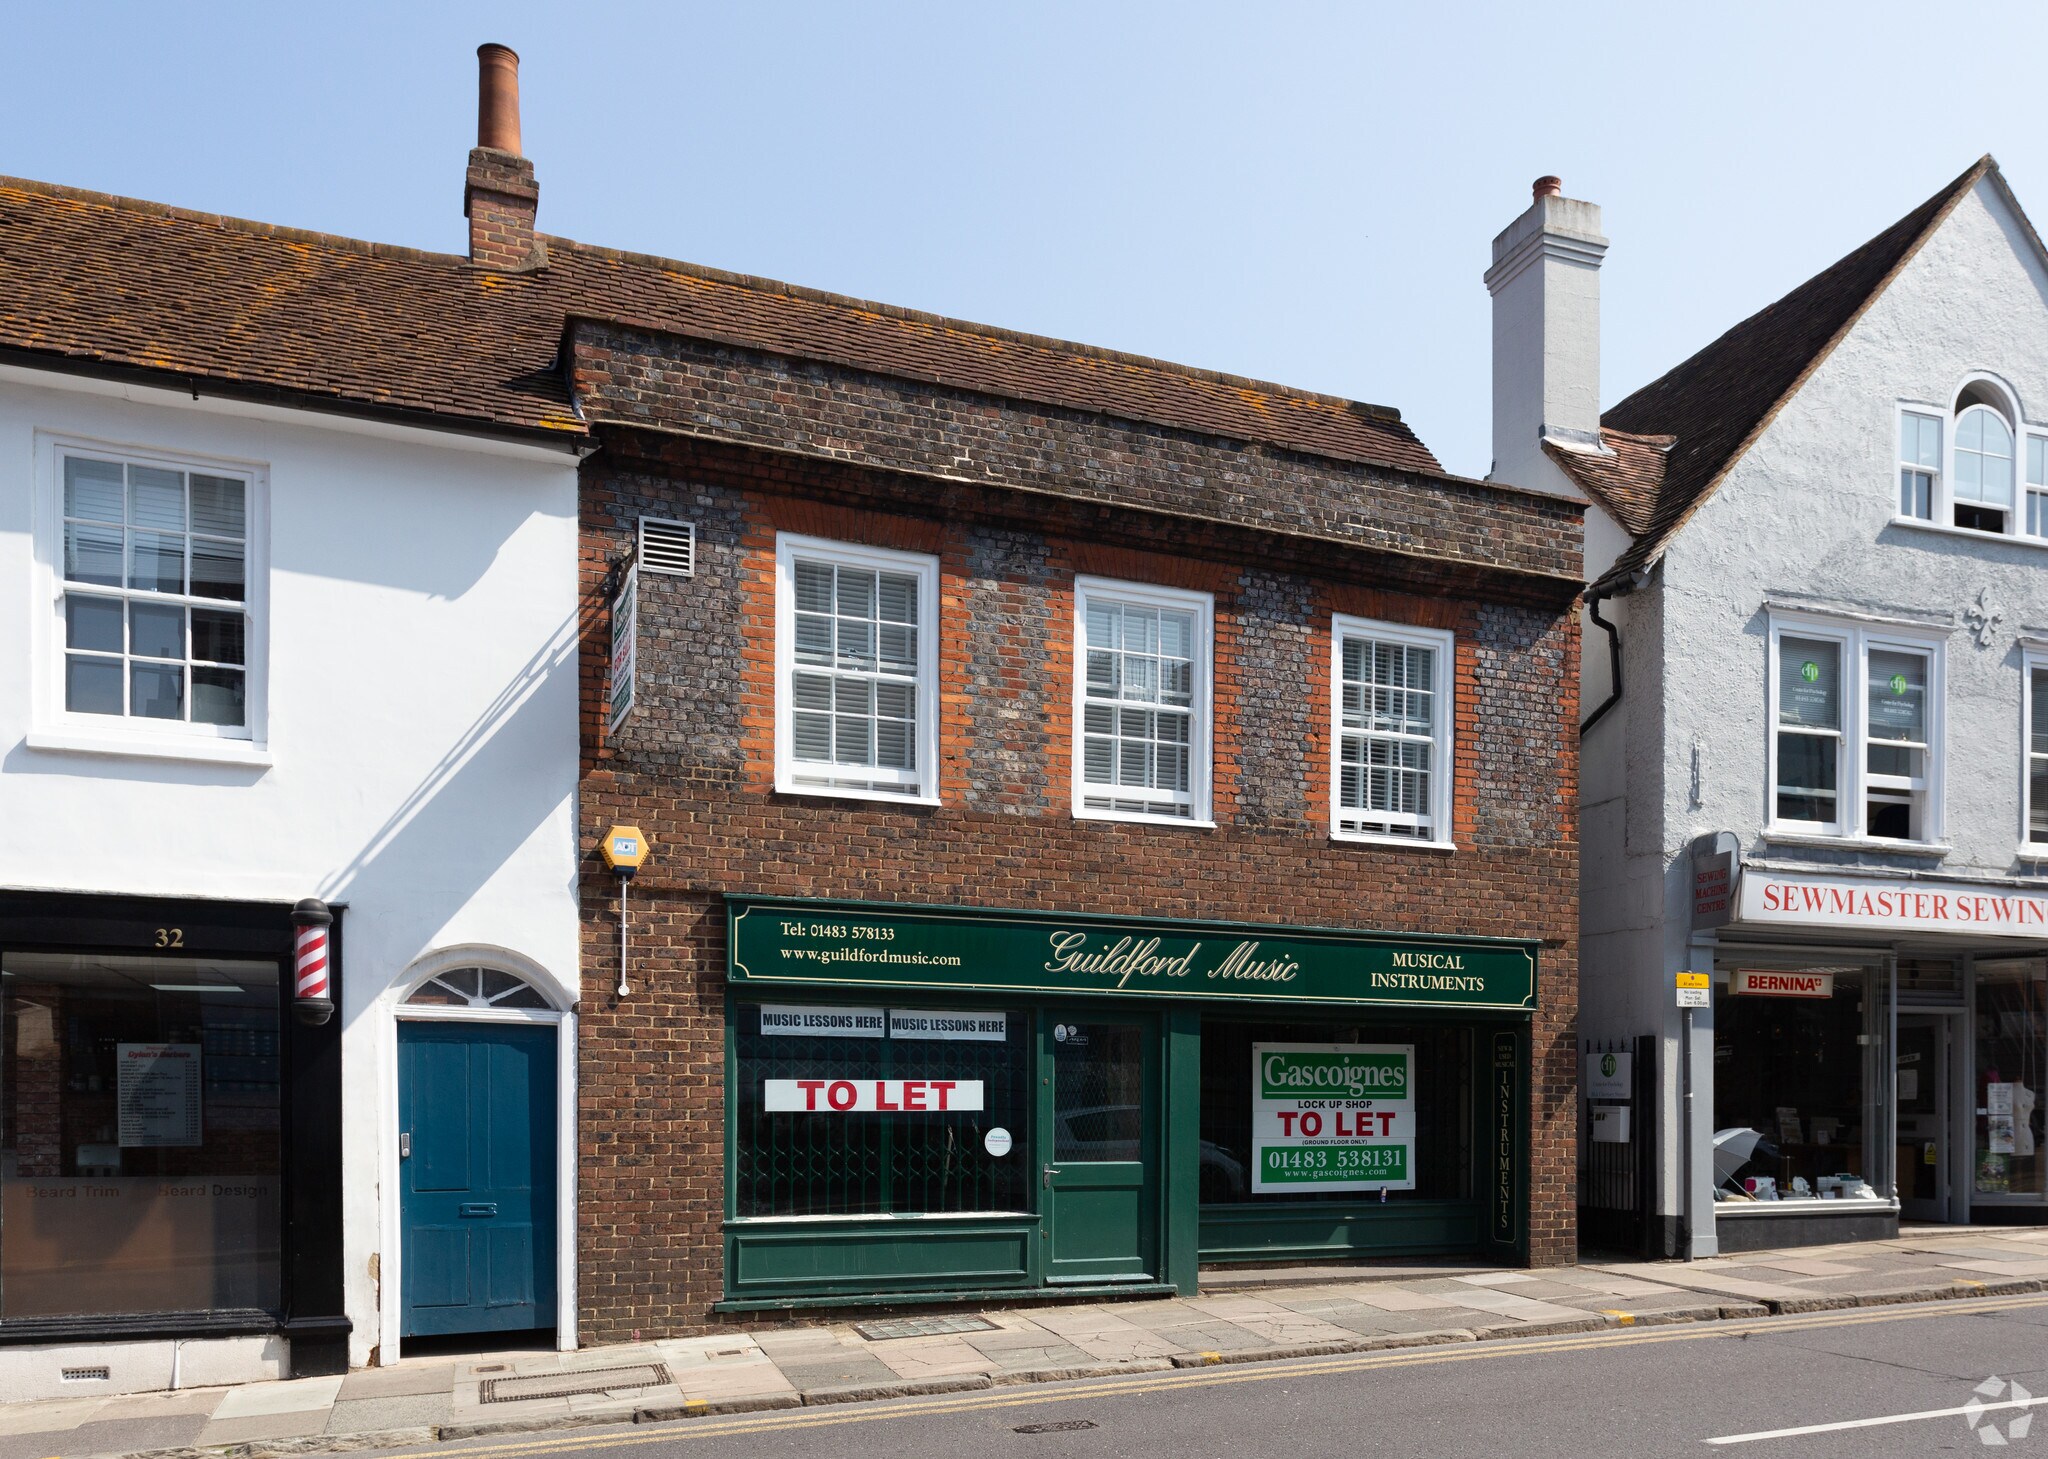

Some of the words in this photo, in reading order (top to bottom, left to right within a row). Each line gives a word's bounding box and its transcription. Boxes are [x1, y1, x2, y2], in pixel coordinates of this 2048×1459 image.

[614, 841, 637, 853] ADT
[1697, 868, 1726, 884] SEWING
[1695, 883, 1728, 899] MACHINE
[1696, 899, 1726, 914] CENTRE
[1762, 884, 1949, 920] SEWMASTER
[1956, 895, 2048, 925] SEWIN
[155, 928, 184, 948] 32
[780, 922, 806, 937] Tel:
[810, 924, 847, 938] 01483
[851, 926, 895, 941] 578133
[780, 948, 961, 966] www.guildfordmusic.com
[1044, 930, 1202, 989] Guildford
[1207, 940, 1300, 982] Music
[1392, 952, 1465, 970] MUSICAL
[1370, 972, 1485, 992] INSTRUMENTS
[1747, 975, 1816, 992] BERNINA
[762, 1013, 801, 1027] MUSIC
[803, 1015, 853, 1028] LESSONS
[855, 1016, 883, 1029] HERE
[891, 1018, 928, 1031] MUSIC
[930, 1019, 976, 1032] LESSONS
[978, 1020, 1004, 1033] HERE
[1264, 1055, 1405, 1097] Gascoignes
[797, 1080, 858, 1111] TO
[876, 1081, 956, 1111] LET
[1297, 1100, 1325, 1109] LOCK
[1329, 1100, 1342, 1109] UP
[1345, 1100, 1372, 1109] SHOP
[1277, 1111, 1323, 1137] TO
[1335, 1112, 1396, 1136] LET
[1499, 1070, 1510, 1228] INSTRUMENTS
[1269, 1150, 1327, 1169] 01483
[1336, 1150, 1402, 1167] 538131
[1284, 1167, 1387, 1179] www.gascoignes.com
[26, 1184, 77, 1198] Beard
[83, 1184, 120, 1198] Trim
[158, 1183, 206, 1197] Beard
[212, 1183, 268, 1199] Design
